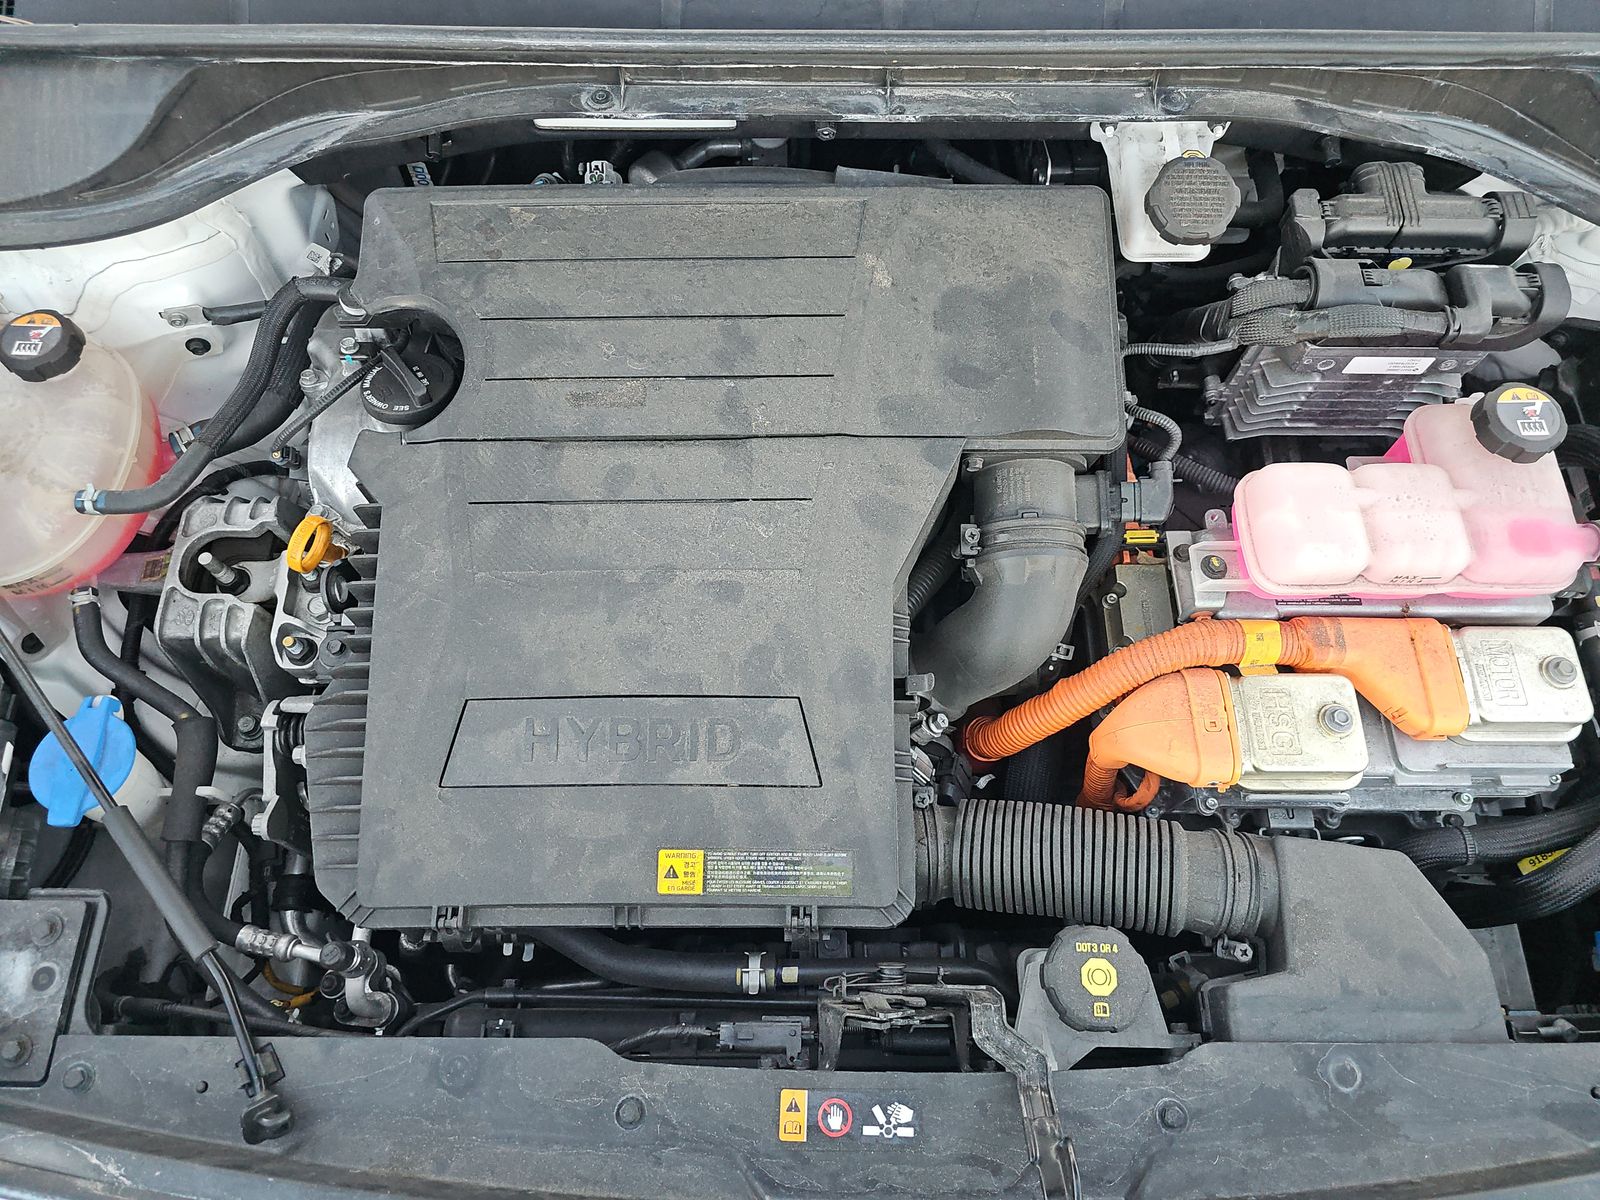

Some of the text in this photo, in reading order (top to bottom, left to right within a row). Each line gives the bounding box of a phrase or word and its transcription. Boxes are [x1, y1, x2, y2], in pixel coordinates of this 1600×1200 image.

[362, 365, 383, 389] MANUAL
[363, 389, 389, 410] OWNER'S
[1485, 643, 1521, 699] MOTOR
[1263, 690, 1296, 749] HSG
[522, 716, 744, 763] HYBRID
[1075, 942, 1119, 954] DOT3 OR 4
